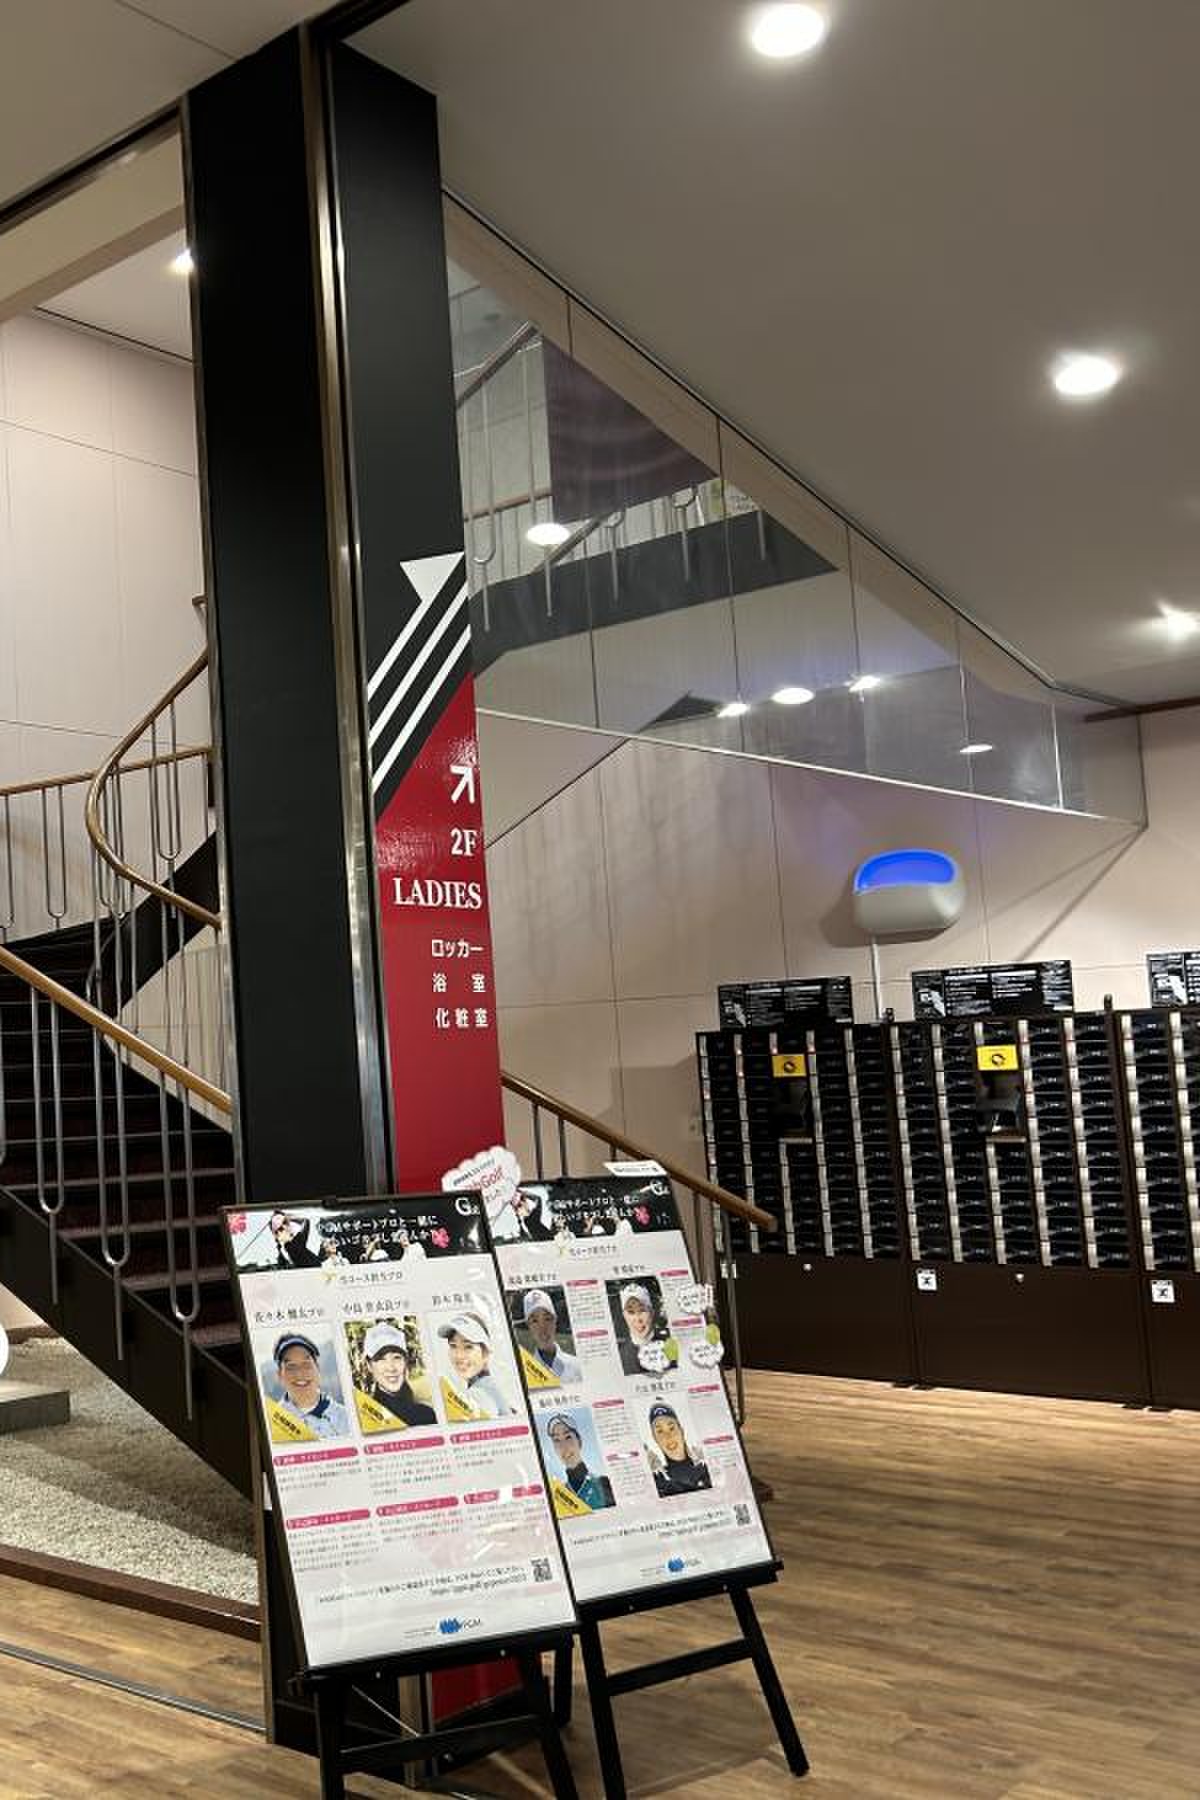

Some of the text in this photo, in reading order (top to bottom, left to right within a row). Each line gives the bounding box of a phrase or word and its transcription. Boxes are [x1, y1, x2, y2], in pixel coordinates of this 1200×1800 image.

[450, 827, 478, 857] 2F
[392, 877, 483, 910] LADIES
[431, 938, 484, 958] ロッカー
[436, 1007, 489, 1029] 化粧室
